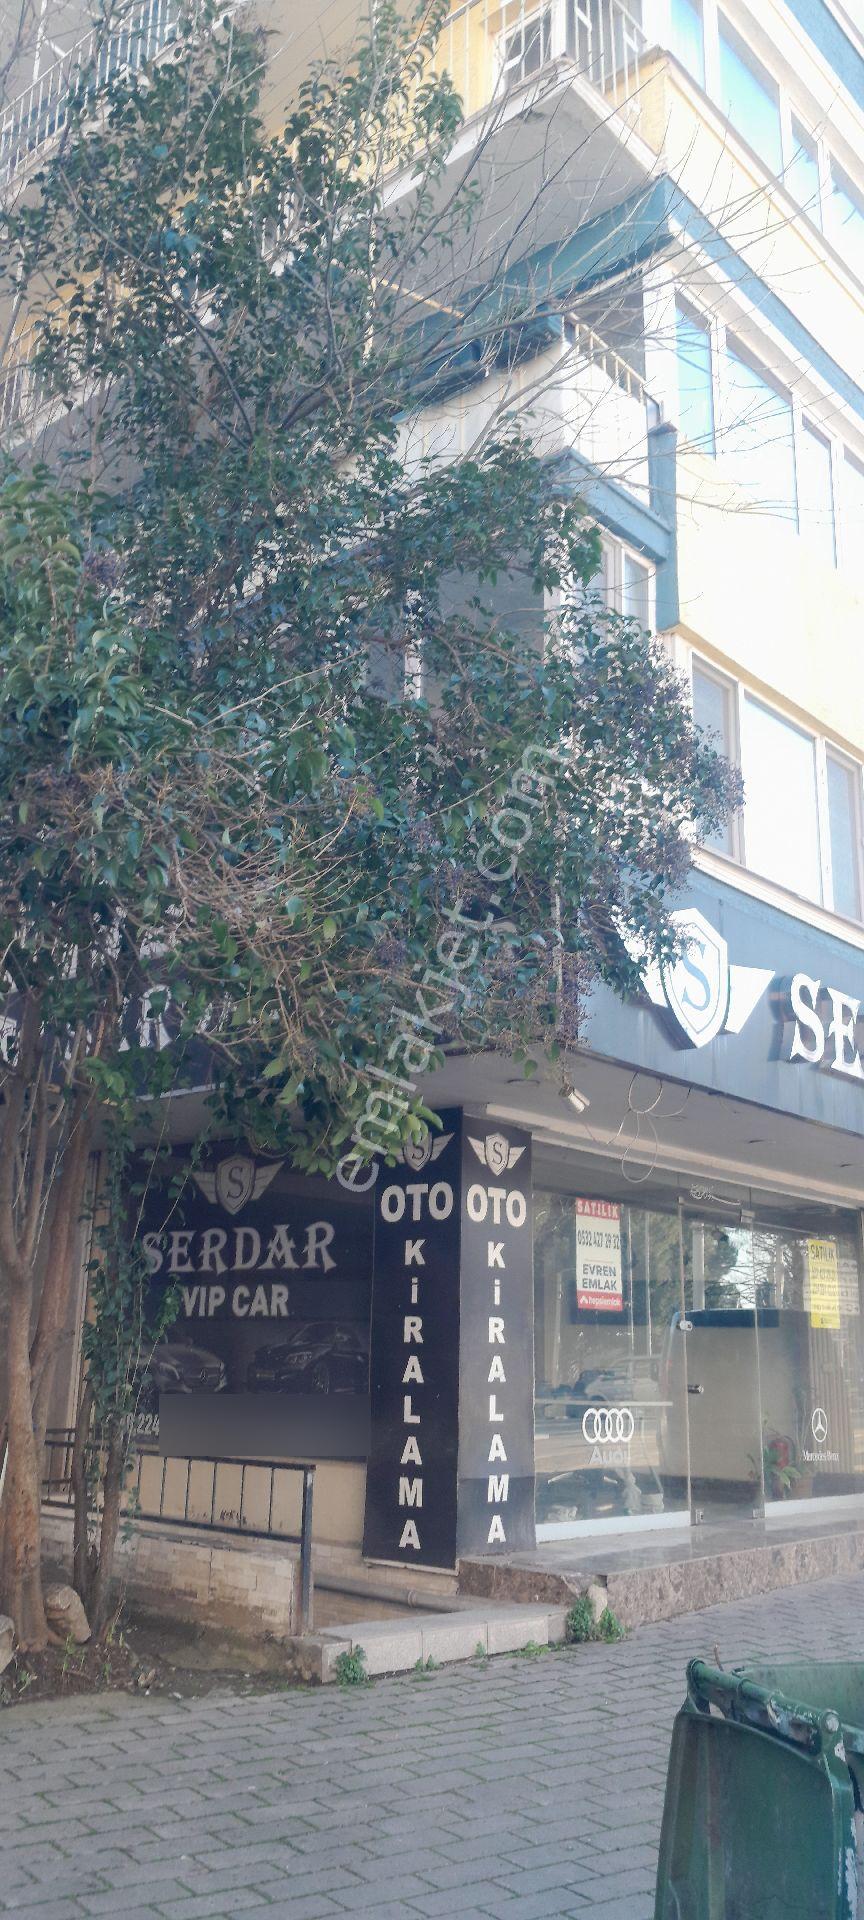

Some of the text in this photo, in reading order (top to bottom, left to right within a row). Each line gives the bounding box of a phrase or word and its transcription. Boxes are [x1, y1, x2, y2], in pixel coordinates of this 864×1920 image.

[790, 973, 864, 1079] SE
[493, 1142, 503, 1164] S
[227, 1166, 243, 1199] S
[380, 1181, 454, 1223] OTO
[466, 1184, 527, 1227] OTO
[577, 1201, 618, 1218] SATILIK
[142, 1221, 337, 1275] SERDAR
[582, 1264, 617, 1277] EVREN
[582, 1278, 617, 1291] EMLAK
[182, 1284, 290, 1317] VIP CAR
